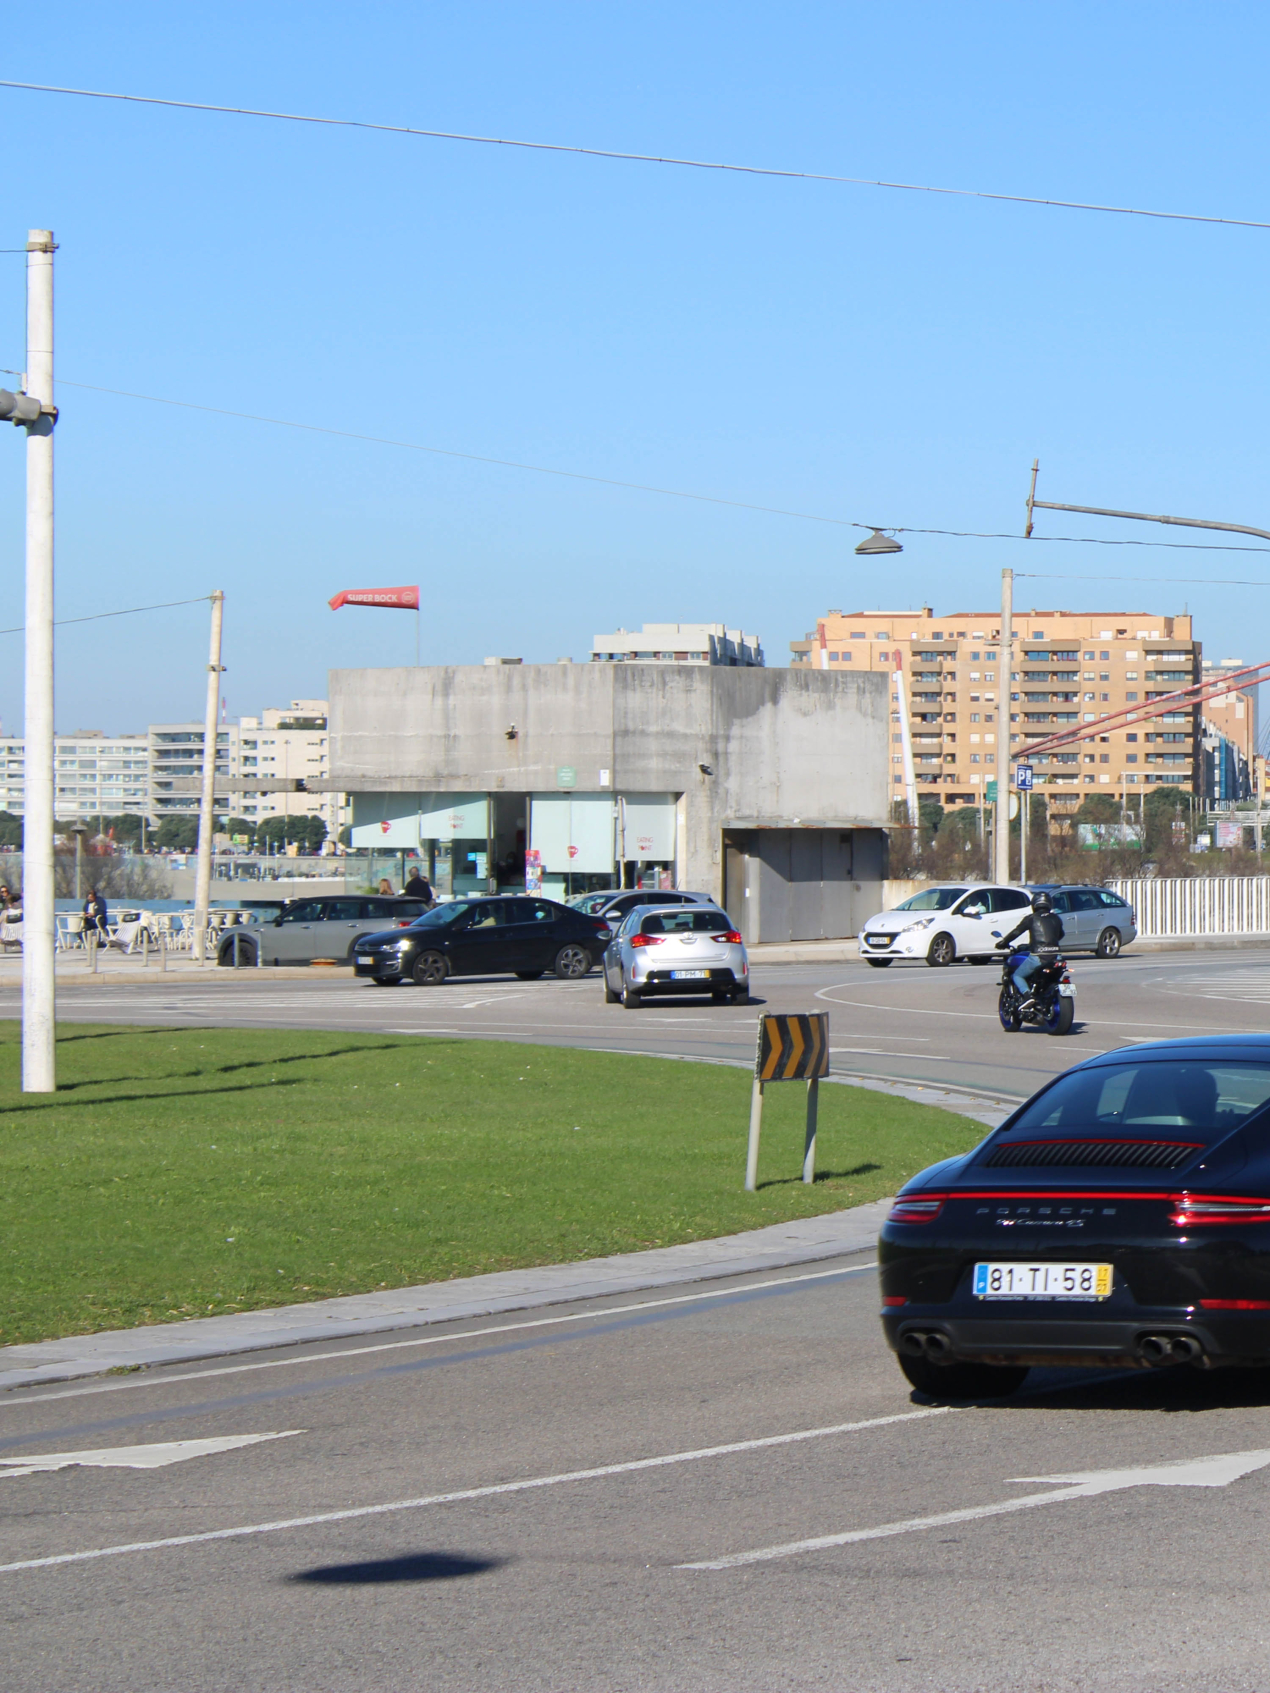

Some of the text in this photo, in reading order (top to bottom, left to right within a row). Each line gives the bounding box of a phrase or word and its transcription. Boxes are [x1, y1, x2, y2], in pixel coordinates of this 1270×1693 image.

[348, 594, 373, 602] SUPER
[374, 594, 398, 602] BOCK
[1018, 772, 1026, 784] P
[976, 1207, 1116, 1215] PORSCHE
